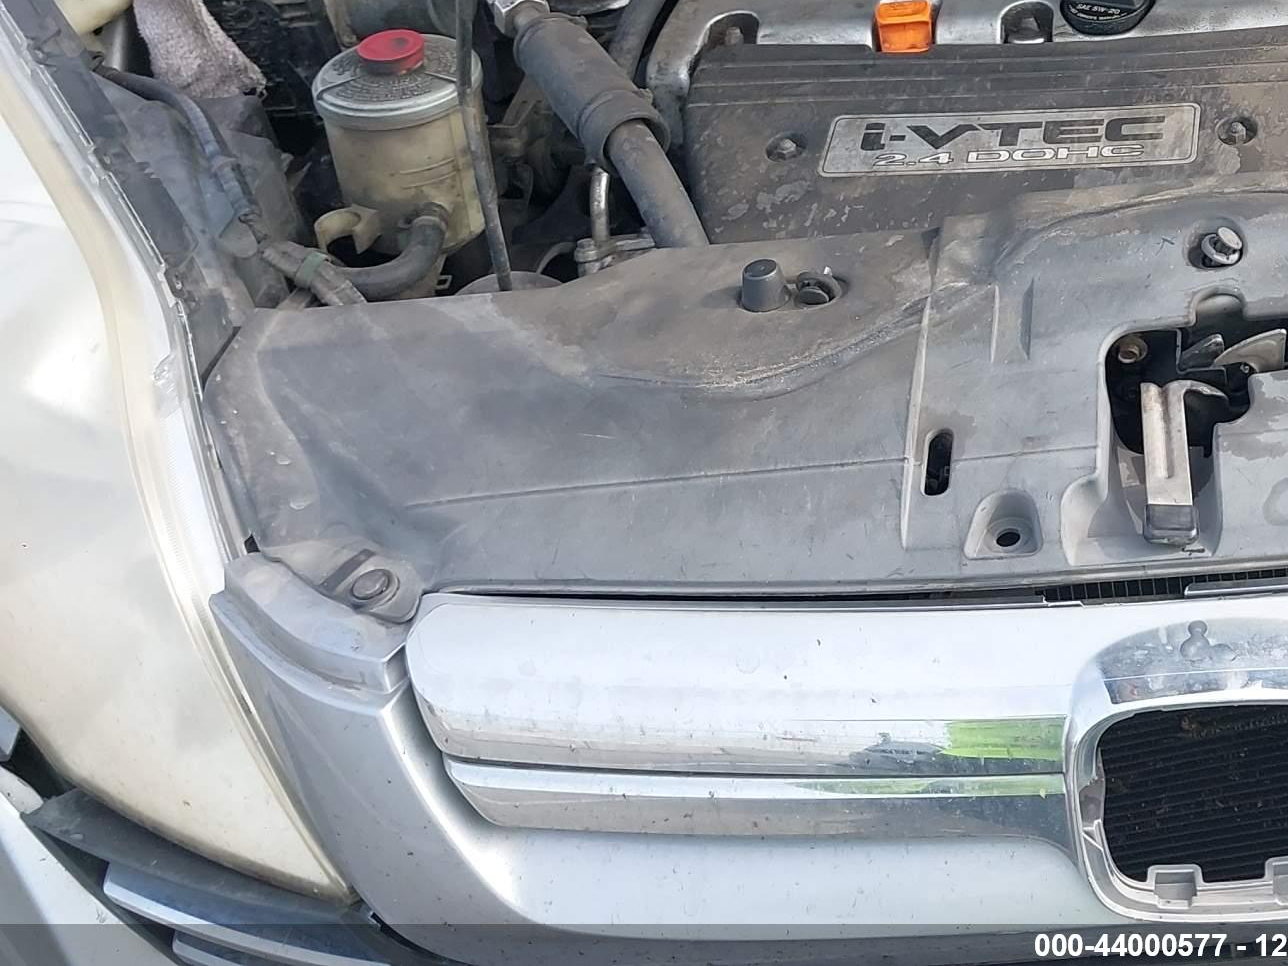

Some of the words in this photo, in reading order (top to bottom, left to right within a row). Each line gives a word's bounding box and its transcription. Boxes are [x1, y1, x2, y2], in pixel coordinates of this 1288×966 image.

[1076, 3, 1091, 11] SAE
[1091, 5, 1121, 15] 5W-20
[860, 115, 1166, 151] i-VTEC
[871, 151, 954, 167] 2.4
[965, 143, 1145, 164] DOHC
